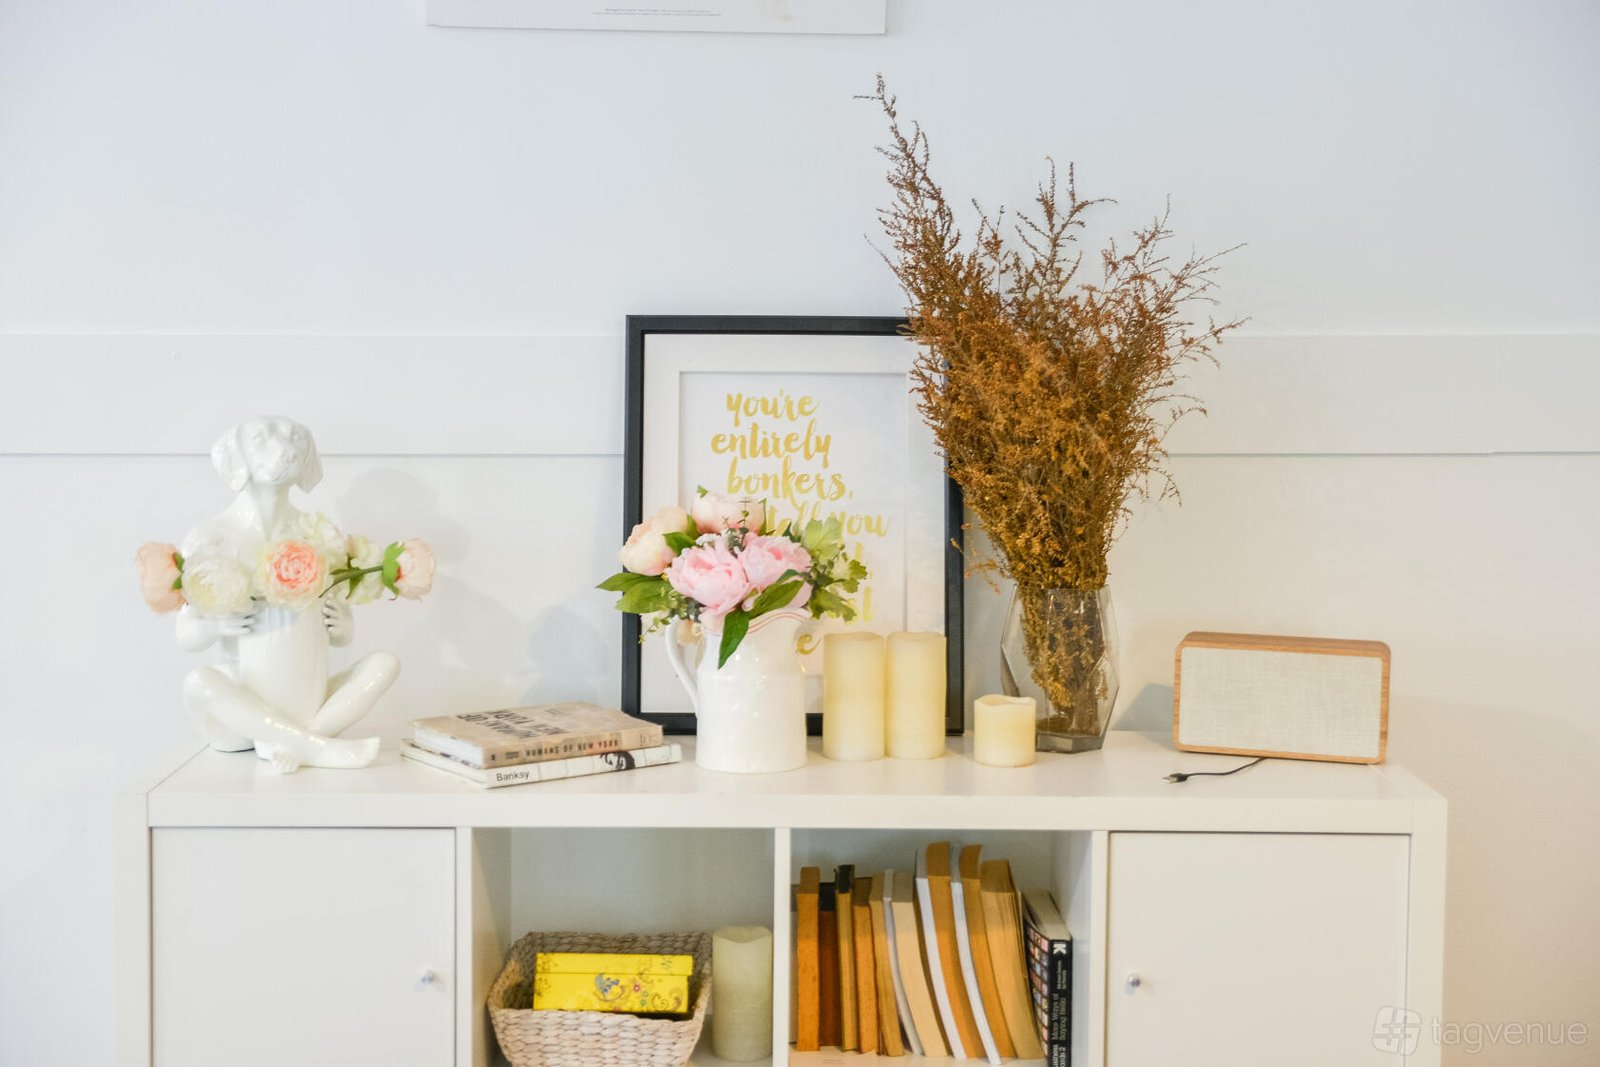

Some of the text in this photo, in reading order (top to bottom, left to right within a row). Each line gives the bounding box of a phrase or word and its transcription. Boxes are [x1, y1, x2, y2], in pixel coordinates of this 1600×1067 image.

[726, 388, 819, 428] you're
[711, 417, 831, 469] entirely
[726, 455, 853, 504] bonkers,
[525, 746, 560, 758] HUMANS
[563, 744, 574, 754] OF
[577, 742, 594, 752] NEW
[598, 738, 619, 750] YORK
[496, 770, 530, 782] Banksy
